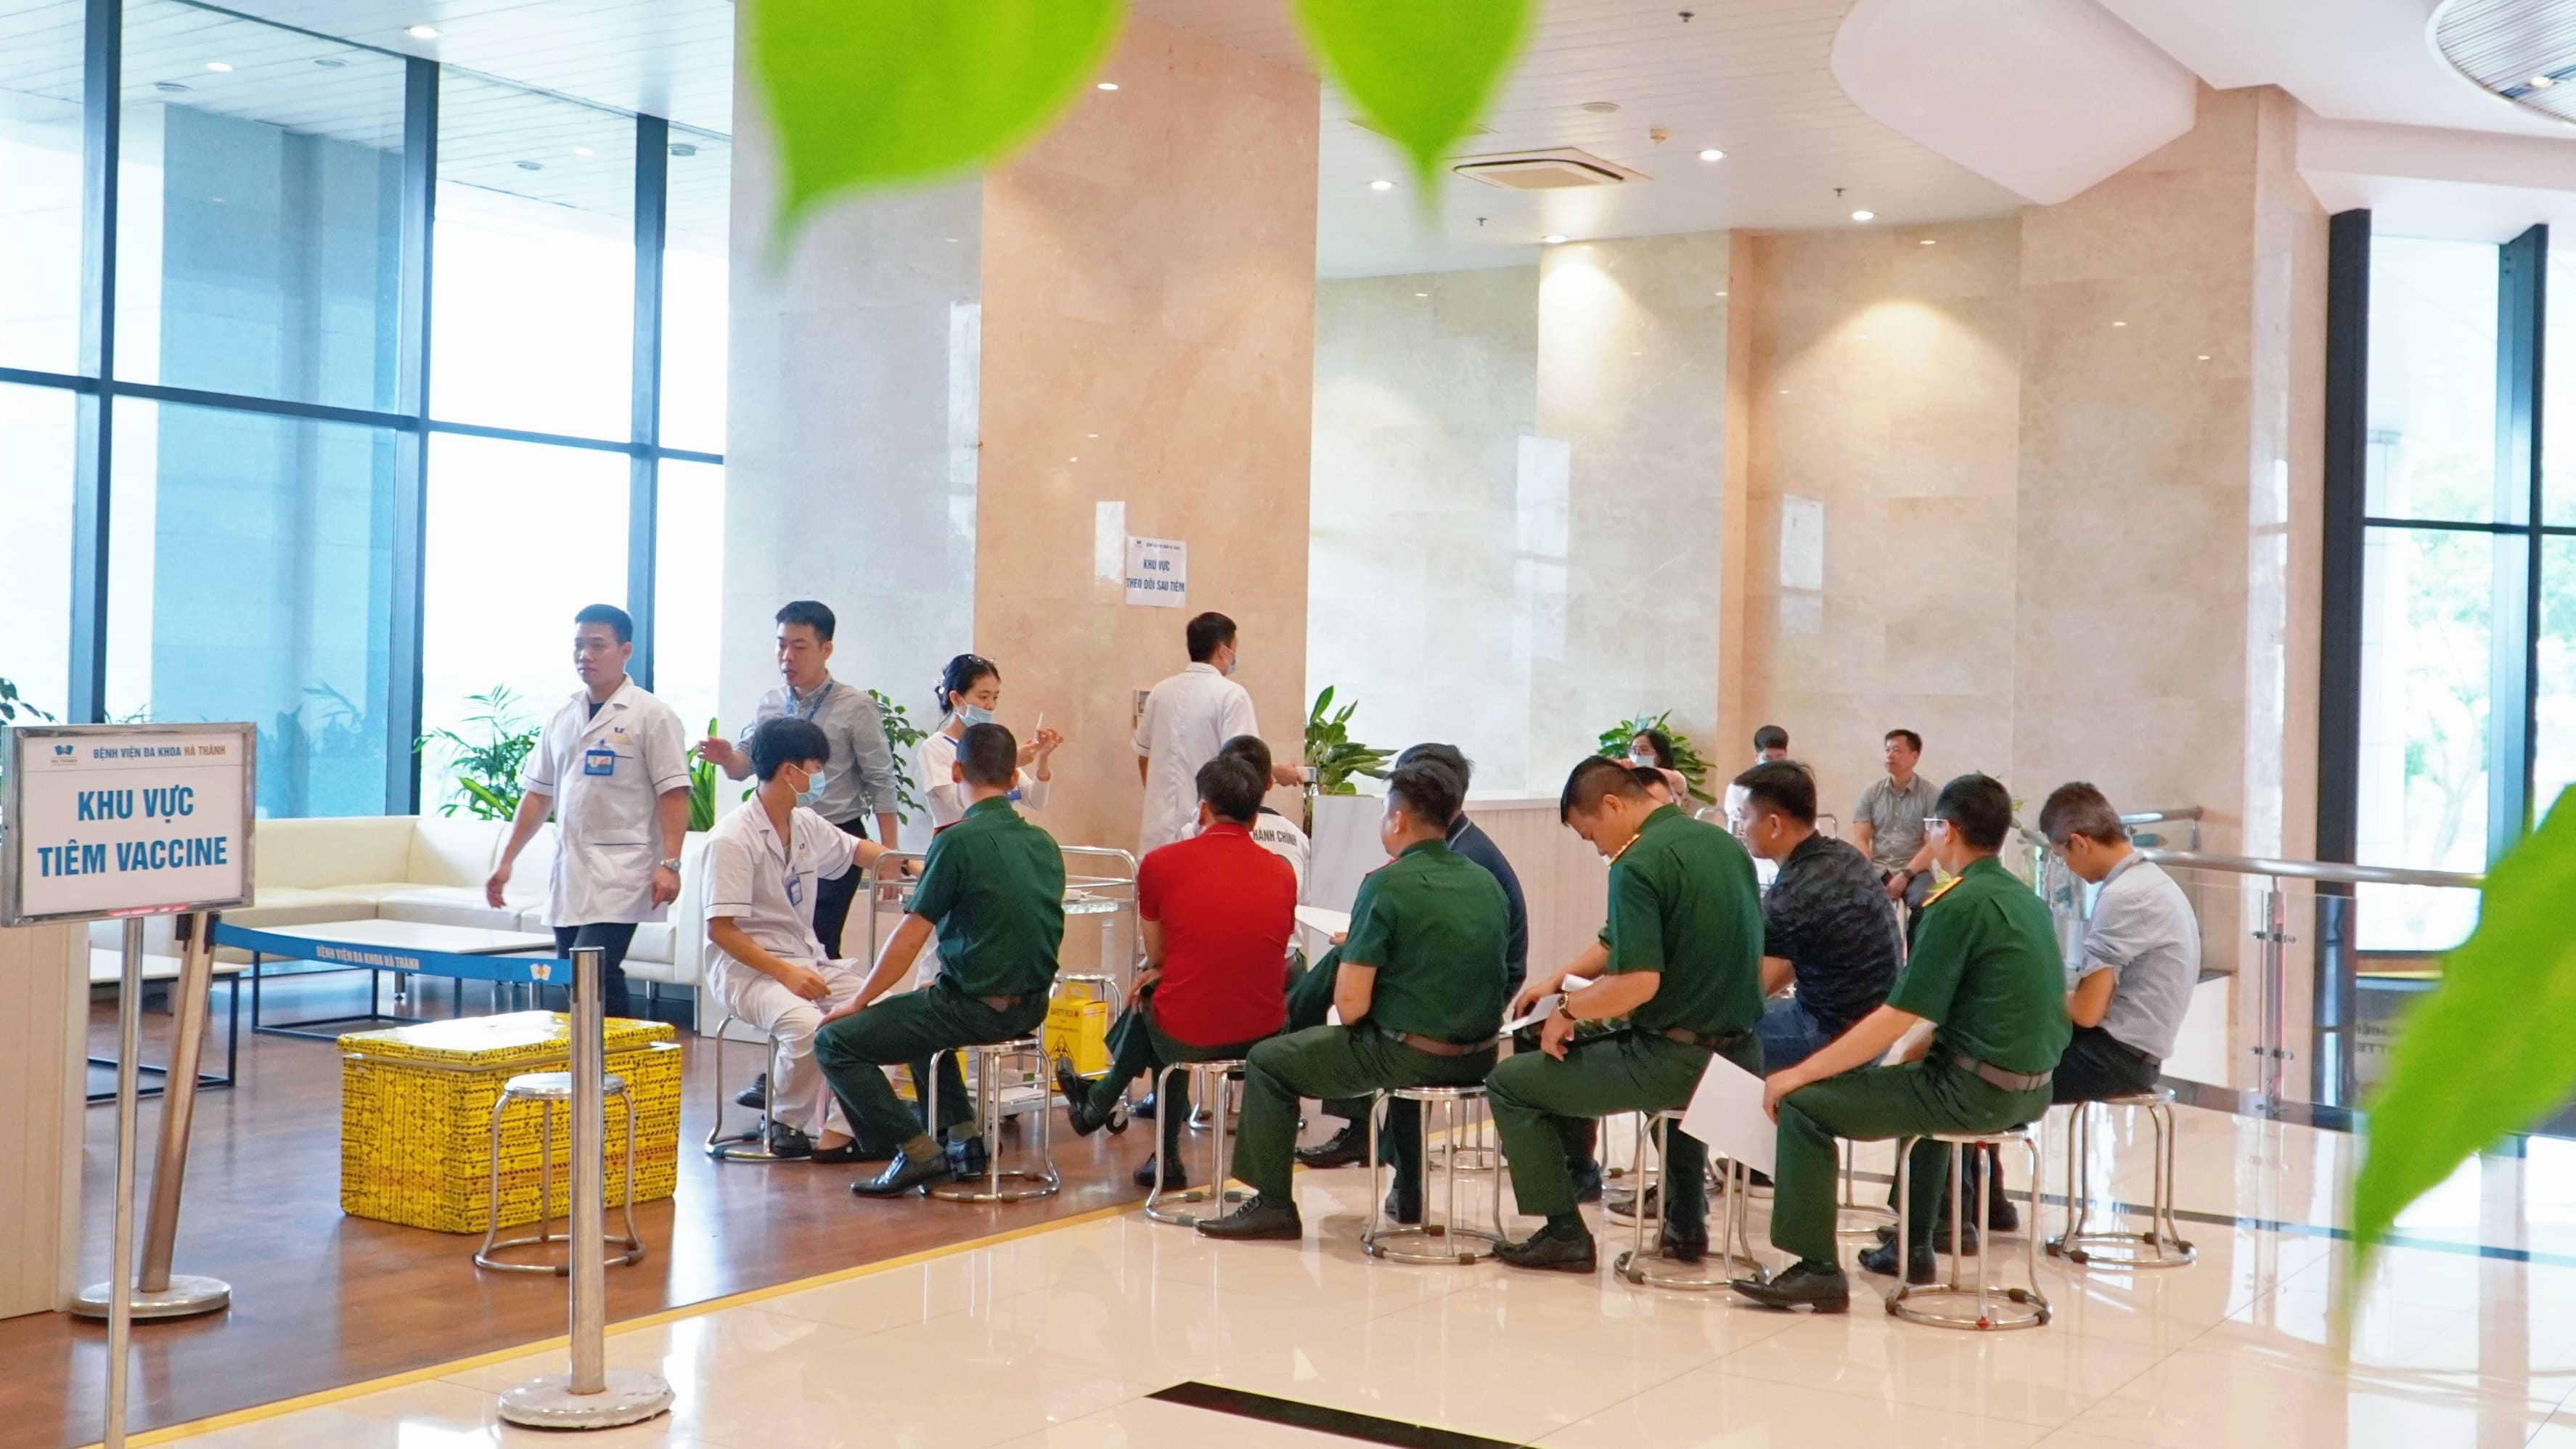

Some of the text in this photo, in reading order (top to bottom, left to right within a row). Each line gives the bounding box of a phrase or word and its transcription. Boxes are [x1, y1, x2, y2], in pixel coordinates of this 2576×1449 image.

[1143, 559, 1156, 570] KHU
[1127, 578, 1142, 589] THEO
[1157, 580, 1169, 591] SAU
[93, 747, 118, 760] BỆNH
[121, 746, 141, 760] VIỆN
[158, 746, 181, 756] KHOA
[78, 784, 194, 823] KHU VỰC
[37, 836, 227, 877] TIÊM VACCINE
